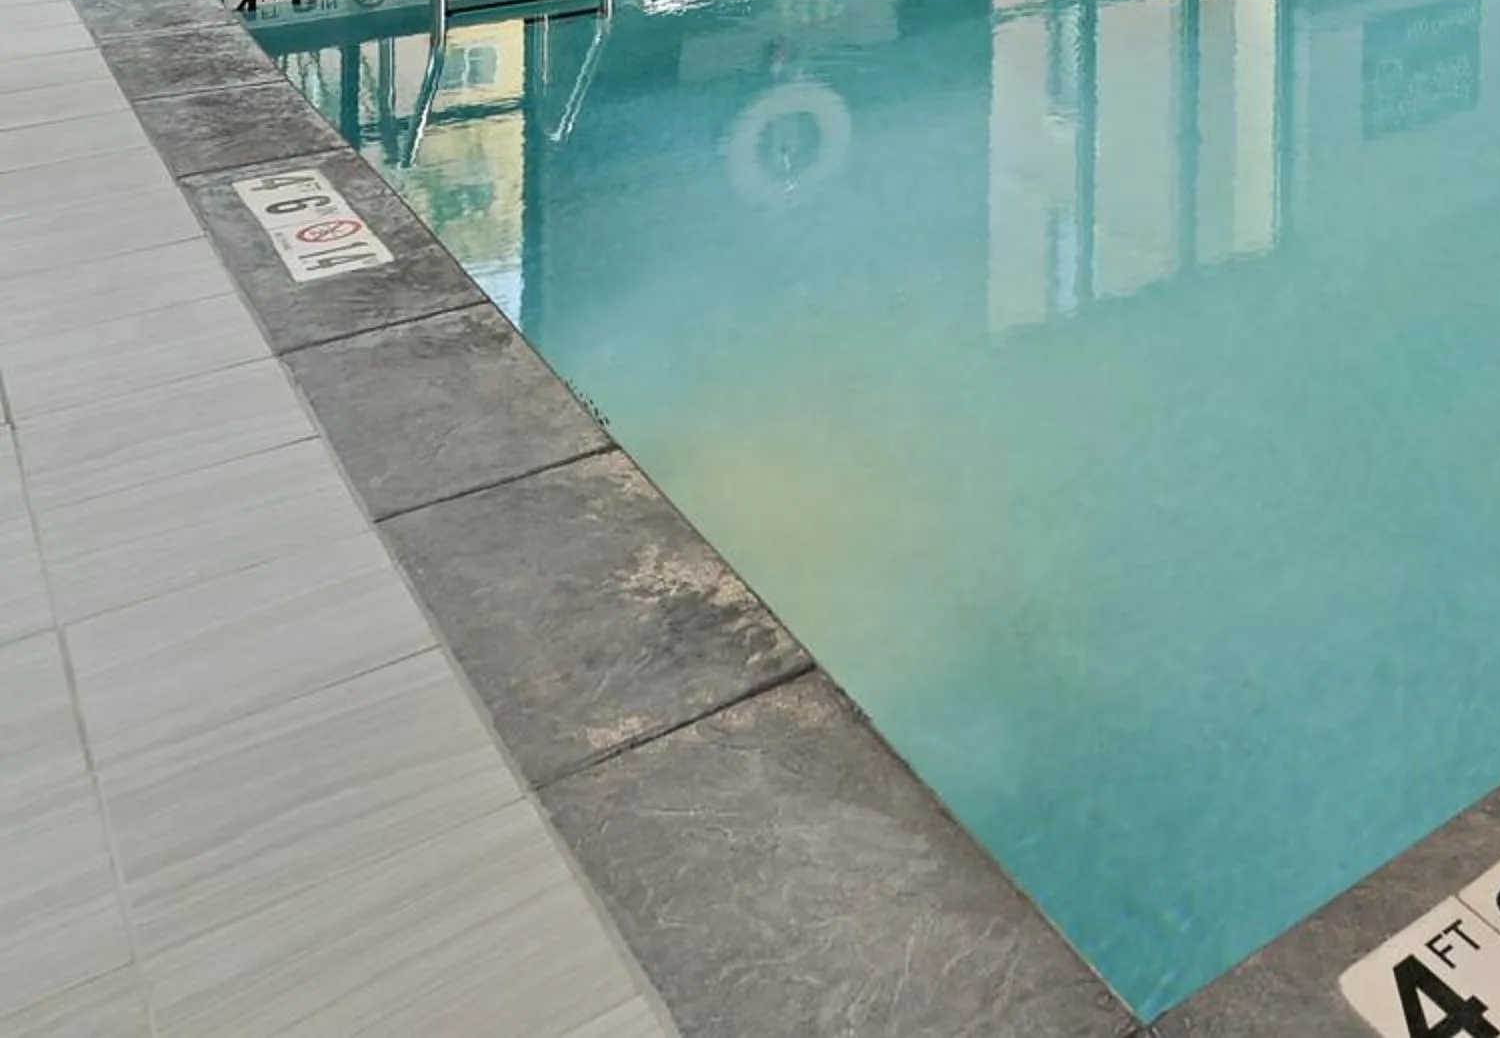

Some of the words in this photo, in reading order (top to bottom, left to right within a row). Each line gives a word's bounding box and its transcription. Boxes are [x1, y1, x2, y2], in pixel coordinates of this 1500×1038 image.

[252, 176, 315, 192] 4
[266, 195, 331, 213] 6
[1424, 919, 1481, 969] FT
[1392, 954, 1500, 1038] 4
